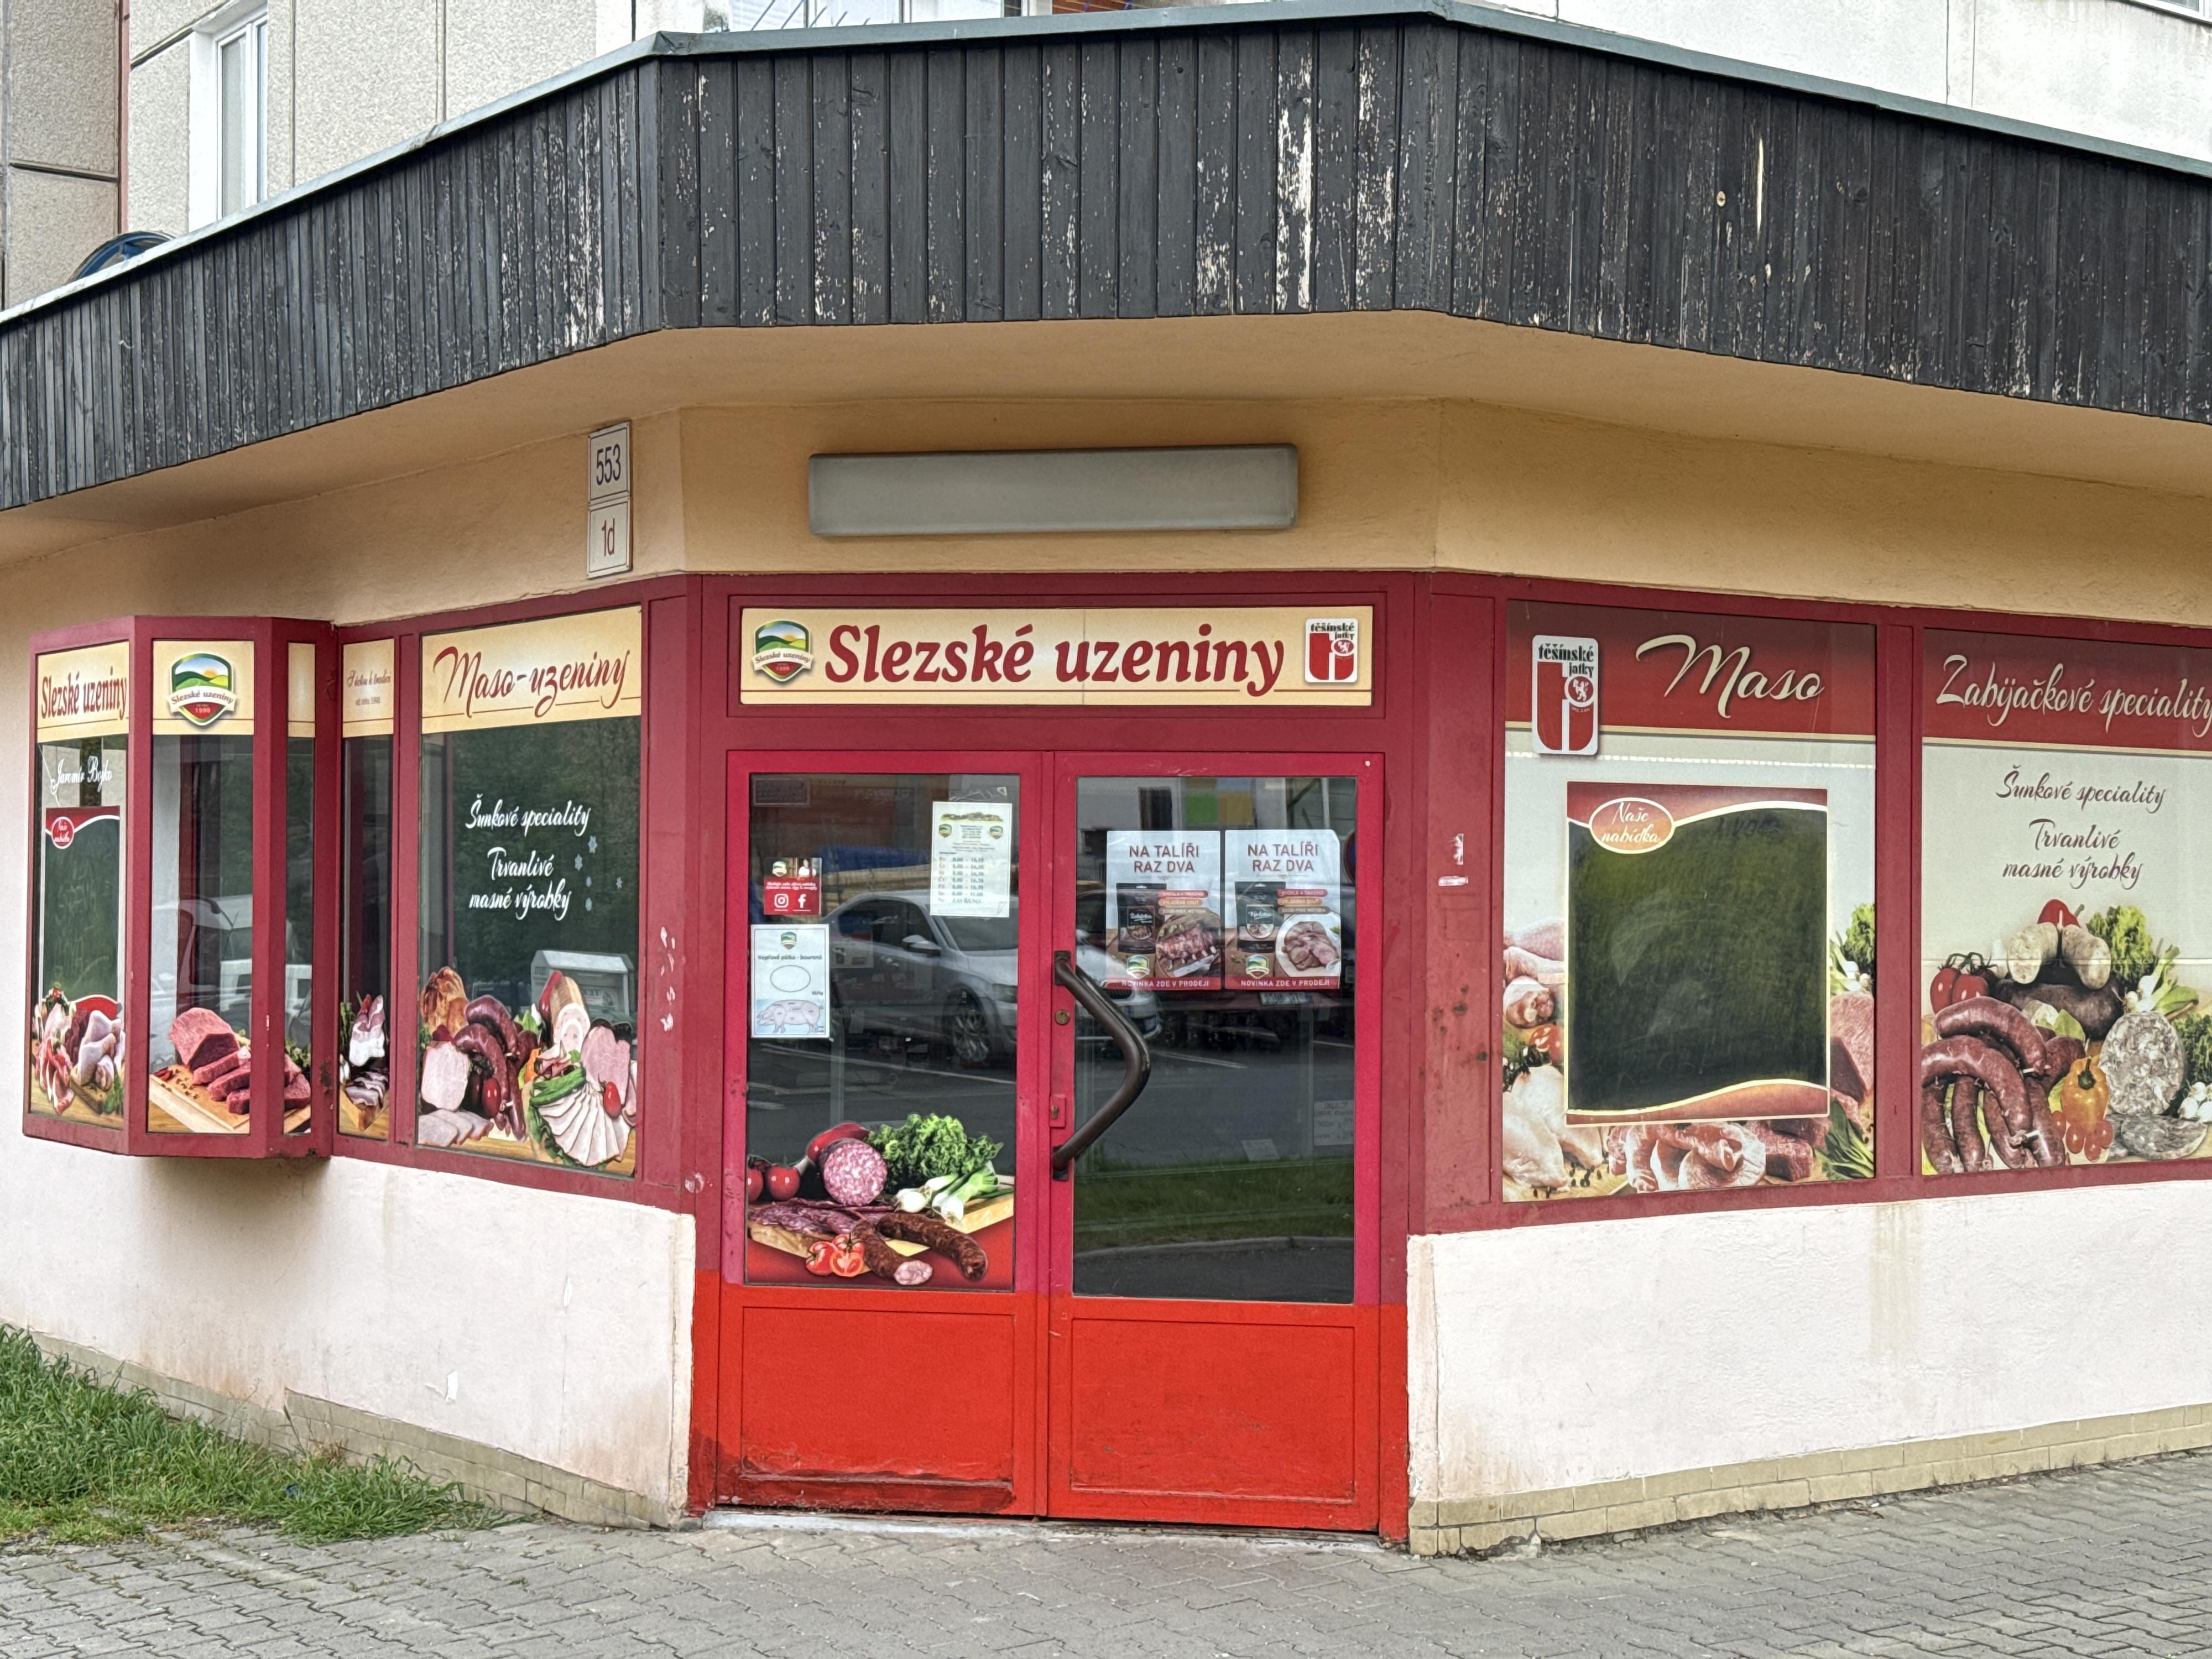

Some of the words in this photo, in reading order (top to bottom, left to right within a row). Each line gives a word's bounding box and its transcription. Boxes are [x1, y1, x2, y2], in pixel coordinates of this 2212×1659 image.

[596, 444, 621, 486] 553
[601, 518, 615, 556] 1d
[1311, 622, 1354, 632] těšínské
[755, 651, 781, 664] Slezské
[782, 653, 810, 663] uzeniny
[825, 623, 1034, 683] Slezské
[1055, 623, 1284, 697] uzeniny
[1538, 643, 1594, 662] těšínské
[434, 646, 630, 718] Maso-uzeniny
[1569, 662, 1594, 678] jatky
[1636, 634, 1824, 718] Maso
[41, 671, 80, 719] Slezské
[83, 666, 127, 721] uzeniny
[171, 690, 201, 705] Slezské
[203, 692, 234, 704] uzeniny
[1936, 654, 2095, 727] Zabijačkové
[2099, 678, 2212, 738] speciality
[50, 759, 85, 795] Jaromír
[1995, 765, 2074, 801] Šunkové
[2075, 780, 2166, 814] speciality
[465, 793, 519, 831] Šunkové
[520, 800, 592, 837] speciality
[1612, 802, 1650, 825] Naše
[1129, 845, 1150, 858] NA
[1154, 842, 1199, 858] TALÍŘI
[1248, 844, 1268, 857] NA
[1272, 841, 1318, 857] TALÍŘI
[1601, 823, 1660, 845] nabídka
[2028, 818, 2121, 850] Trvanlivé
[487, 847, 555, 880] Trvanlivé
[1134, 860, 1162, 873] RAZ
[1167, 860, 1195, 873] DVA
[1253, 859, 1281, 872] RAZ
[1286, 859, 1314, 872] DVA
[2002, 858, 2064, 879] masné
[2069, 852, 2143, 890] výrobky
[469, 886, 513, 909] masné
[515, 878, 572, 921] výrobky
